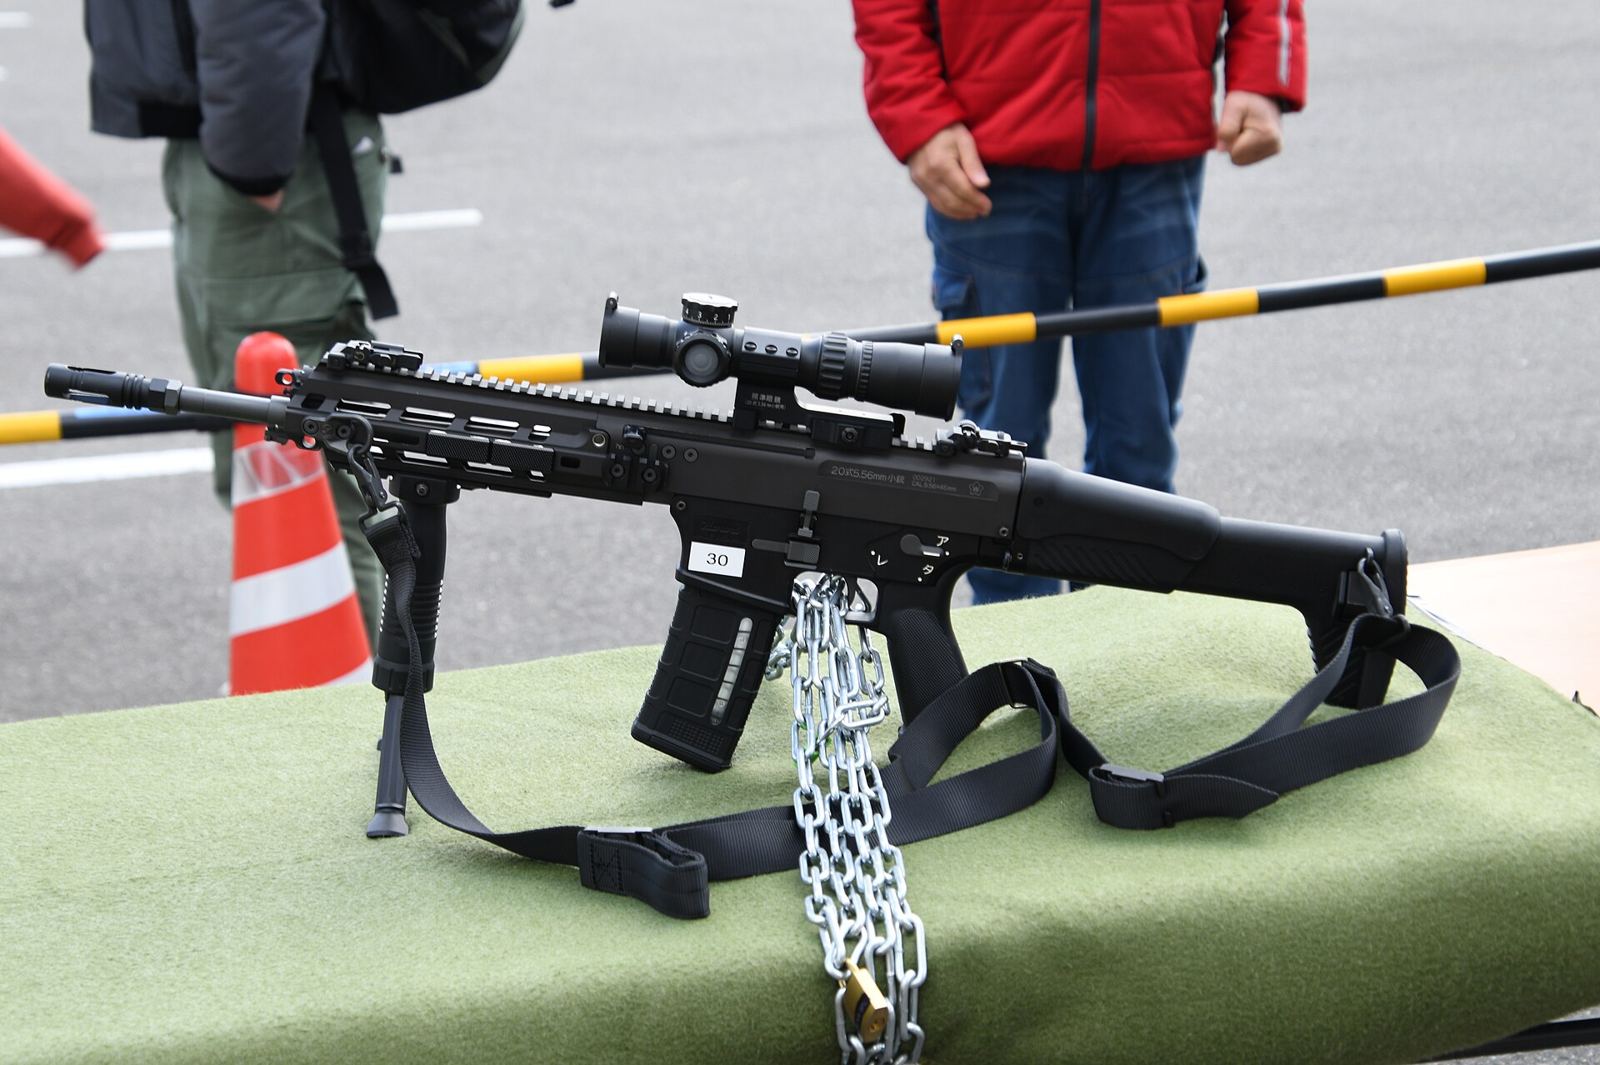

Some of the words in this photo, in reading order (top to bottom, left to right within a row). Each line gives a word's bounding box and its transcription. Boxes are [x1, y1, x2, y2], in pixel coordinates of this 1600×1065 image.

[936, 535, 949, 547] ア
[706, 552, 728, 567] 30
[877, 555, 888, 566] レ
[923, 564, 934, 575] タ
